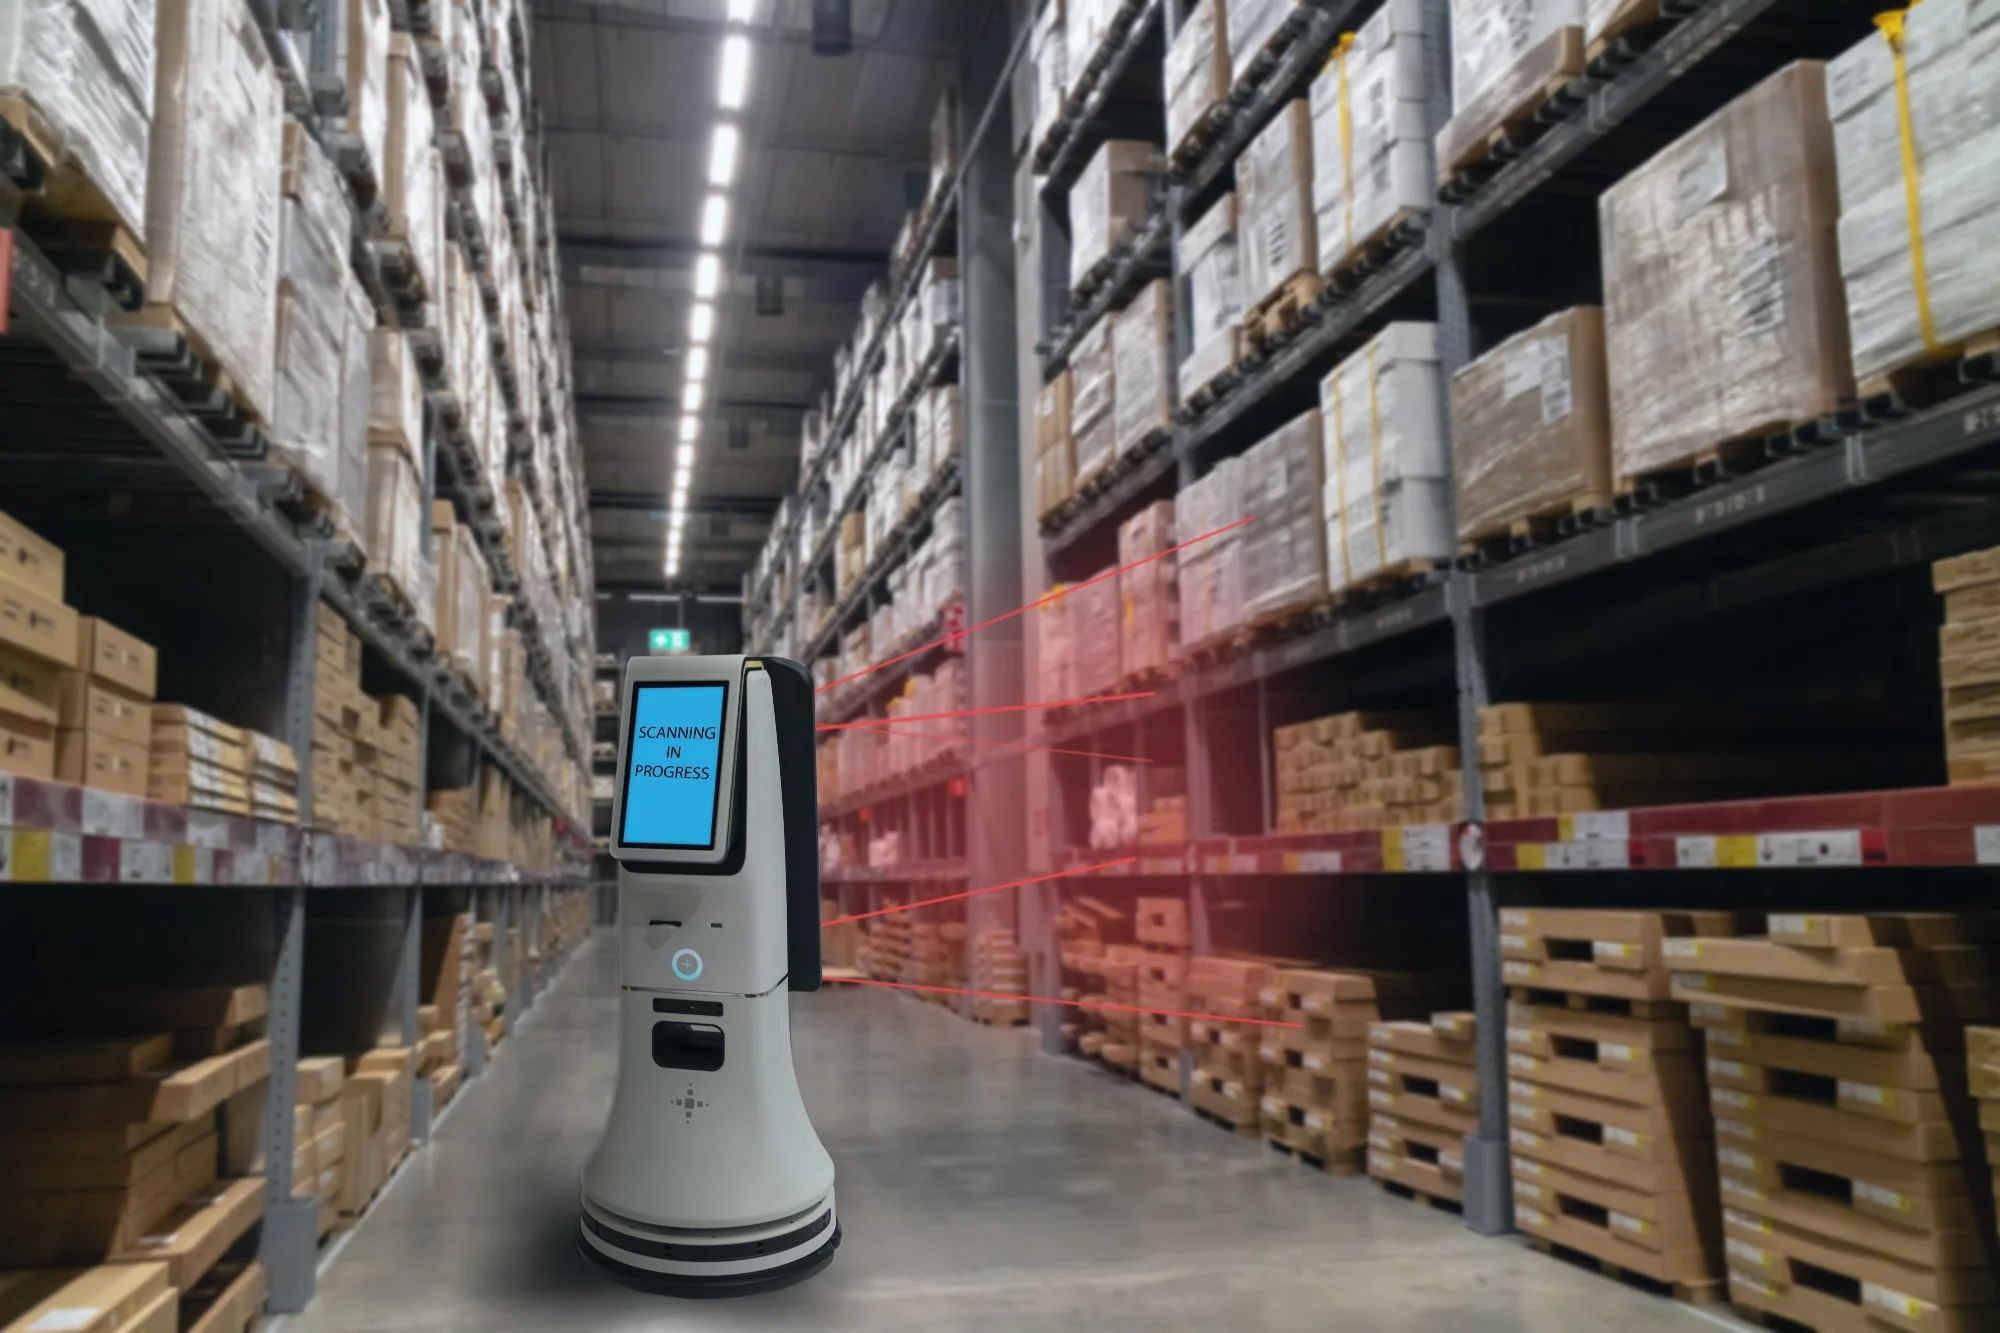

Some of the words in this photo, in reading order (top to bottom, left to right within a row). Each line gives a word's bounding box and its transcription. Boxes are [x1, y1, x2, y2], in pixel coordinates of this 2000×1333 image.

[638, 726, 716, 740] SCANNING
[666, 746, 681, 758] IN
[635, 764, 710, 780] PROGRESS
